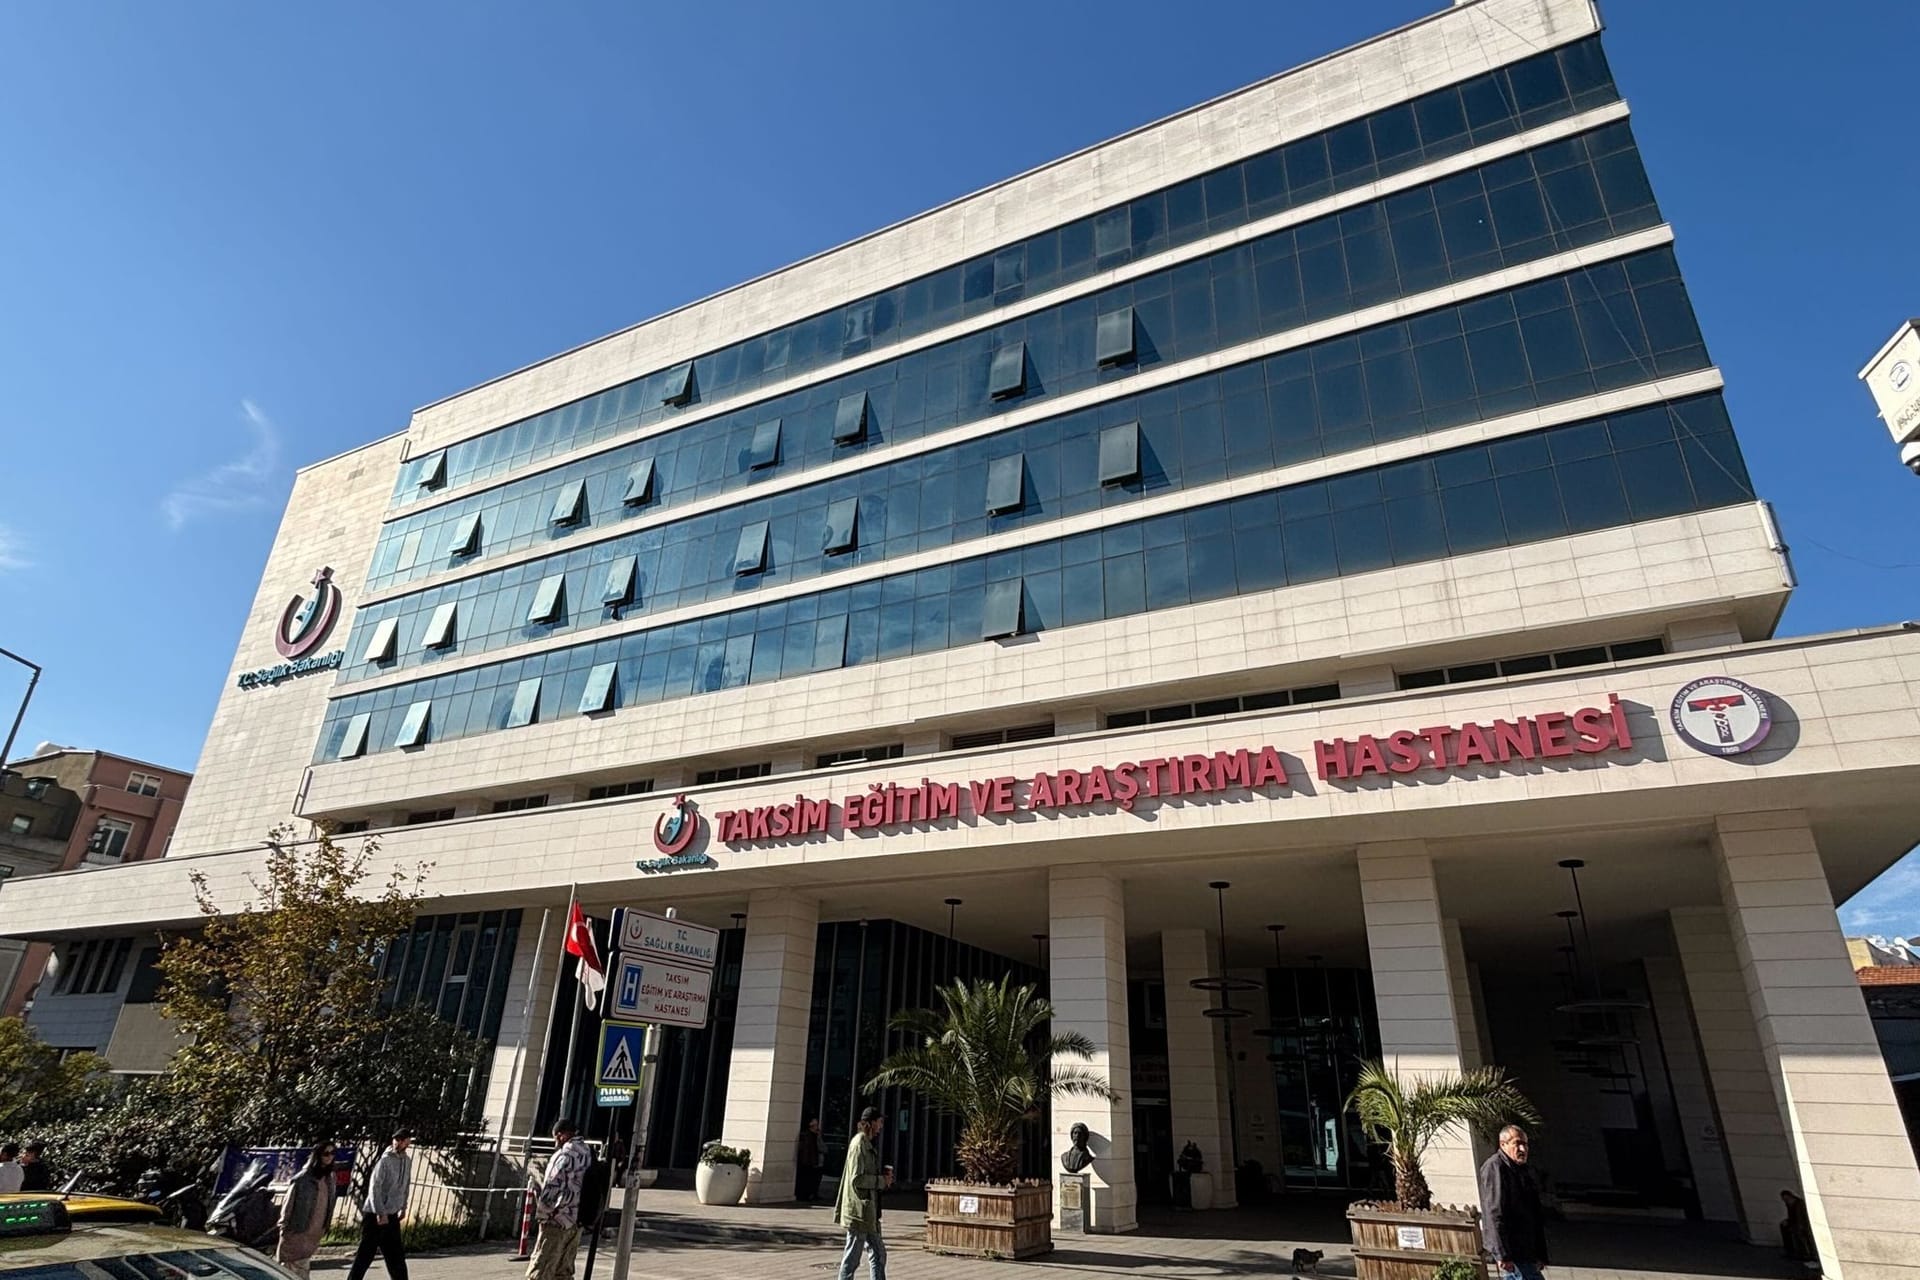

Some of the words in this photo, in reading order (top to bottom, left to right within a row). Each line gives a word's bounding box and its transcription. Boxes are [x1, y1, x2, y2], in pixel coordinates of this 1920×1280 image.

[255, 662, 289, 683] Sağlık
[289, 650, 345, 674] Bakanlığı
[715, 794, 830, 842] TAKSİM
[842, 777, 960, 830] EĞİTİM
[969, 776, 1016, 816] VE
[1028, 745, 1288, 811] ARAŞTIRMA
[1314, 693, 1633, 781] HASTANESİ
[643, 936, 673, 951] SAĞLIK
[674, 942, 714, 959] BAKANLIĞI
[623, 971, 639, 1002] H
[665, 972, 690, 986] TAKSİM
[641, 983, 664, 997] EĞİTİM
[664, 988, 673, 999] VE
[673, 990, 706, 1003] ARAŞTIRMA
[654, 1004, 691, 1017] HASTANESİ
